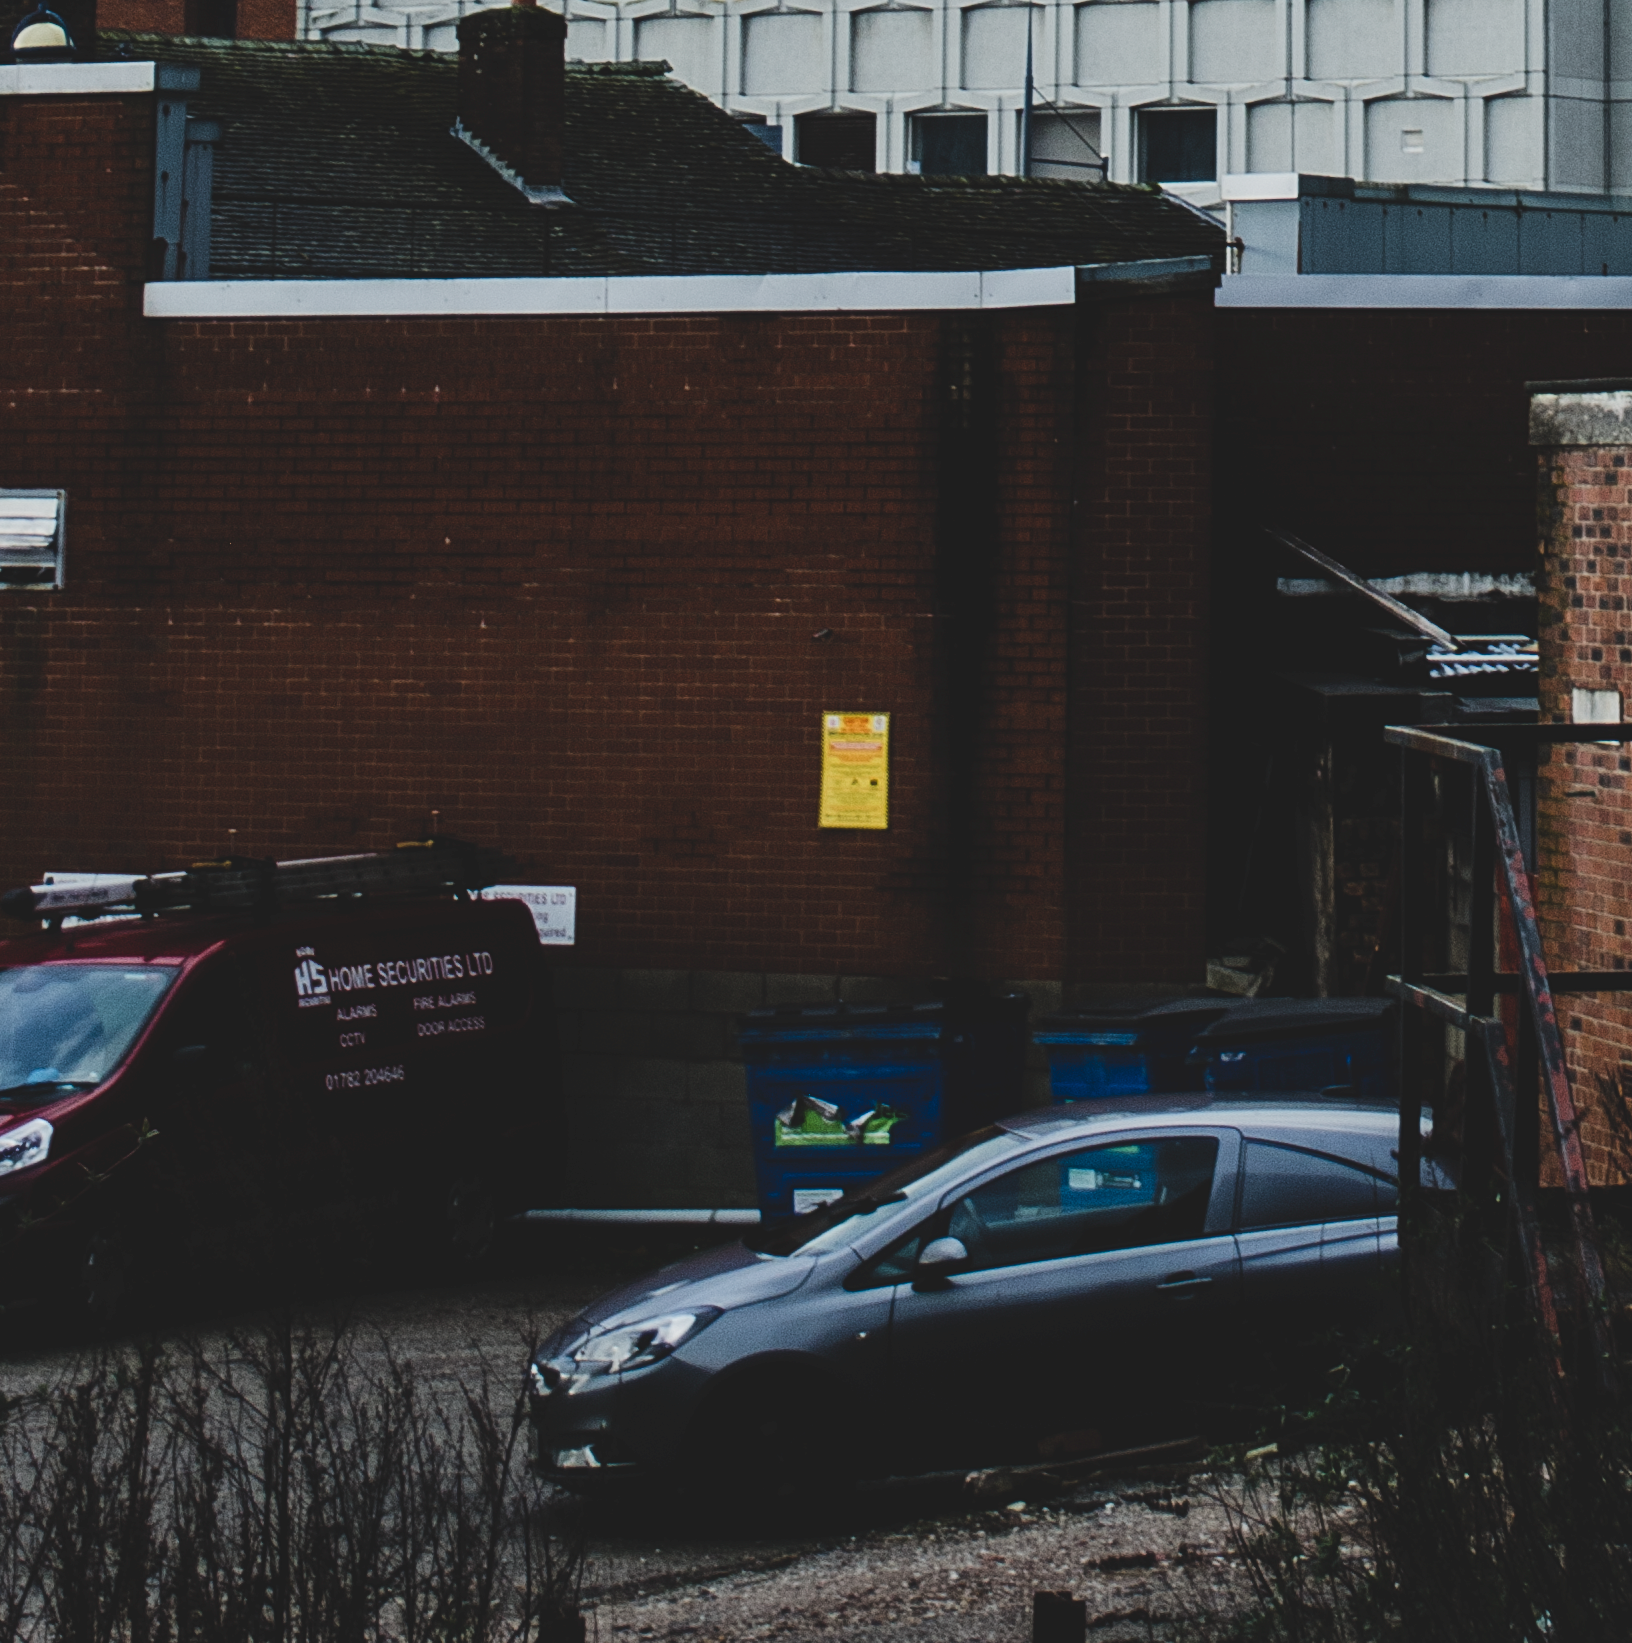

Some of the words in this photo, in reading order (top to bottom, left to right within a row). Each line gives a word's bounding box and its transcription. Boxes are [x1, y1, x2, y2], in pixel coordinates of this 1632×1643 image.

[328, 964, 376, 992] HOME
[376, 954, 464, 987] SECURITIES
[466, 951, 494, 977] LTD
[413, 995, 435, 1010] FIRE
[437, 990, 477, 1007] ALARMS
[336, 1003, 378, 1021] ALARMS
[417, 1020, 445, 1037] DOOR
[447, 1016, 486, 1033] ACCESS
[339, 1031, 366, 1047] CCTV
[325, 1070, 361, 1090] 01782
